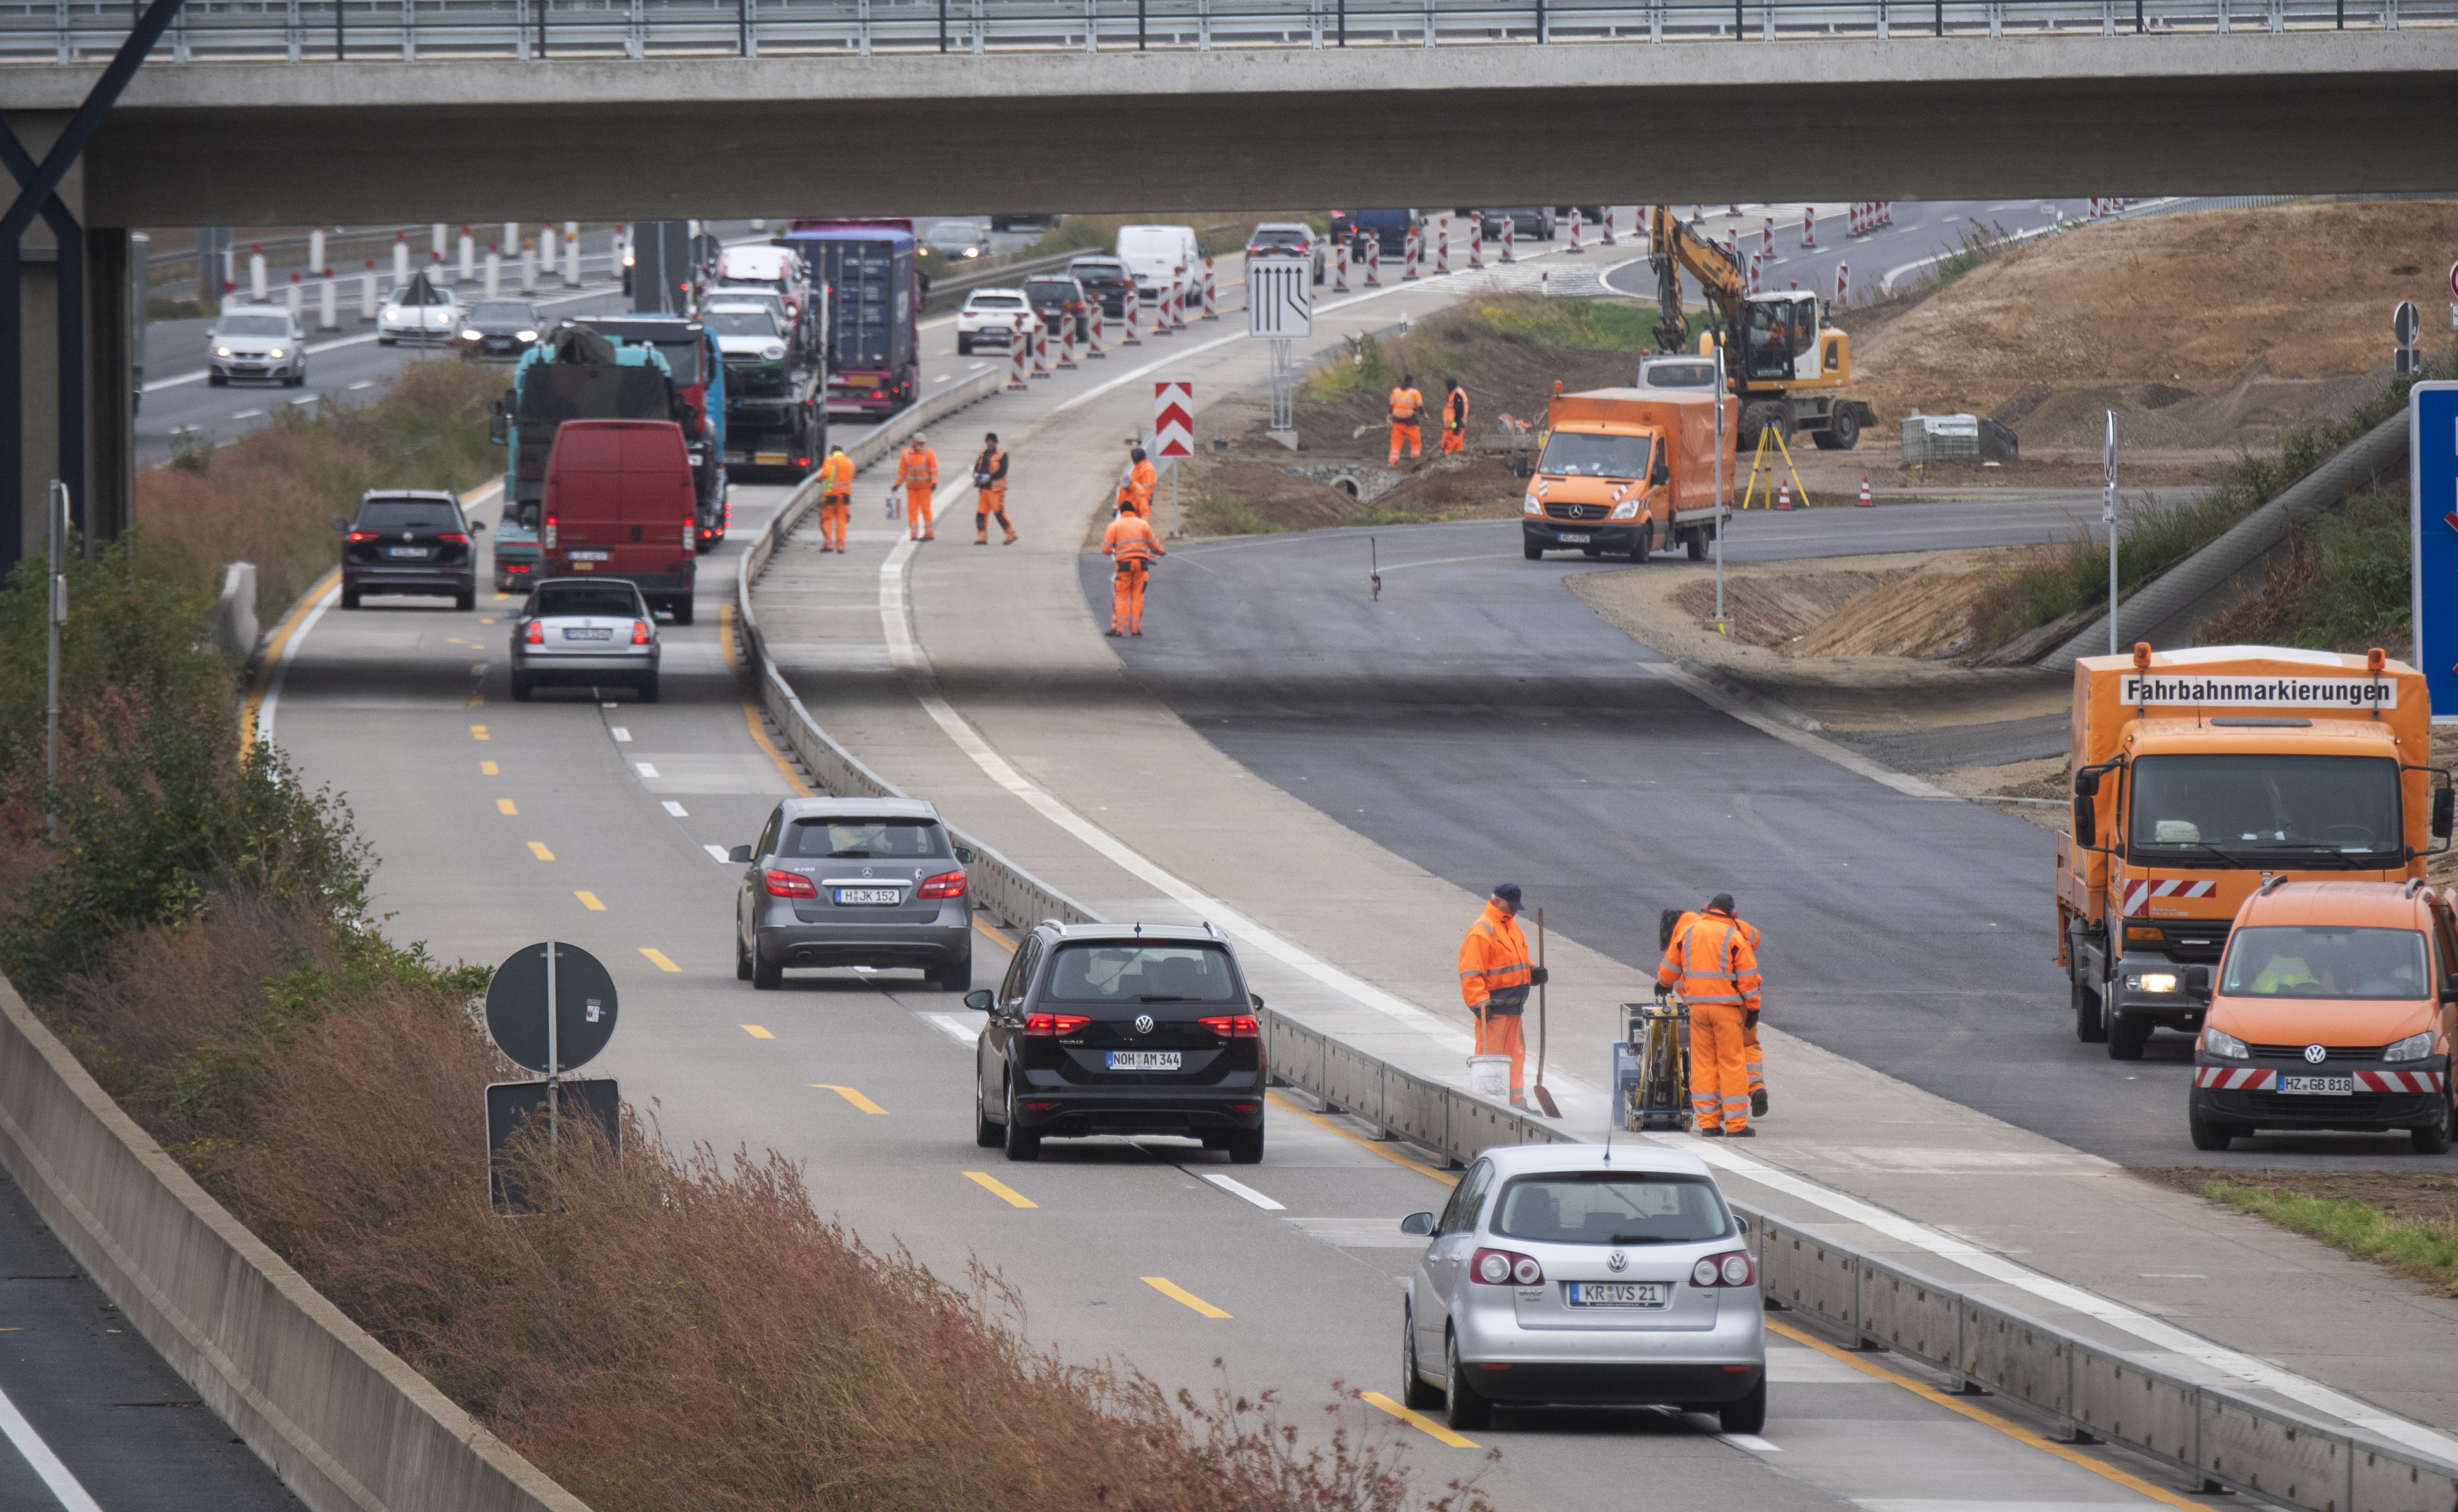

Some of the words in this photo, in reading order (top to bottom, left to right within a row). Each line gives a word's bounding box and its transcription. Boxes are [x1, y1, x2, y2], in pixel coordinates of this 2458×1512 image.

[2128, 680, 2390, 705] Fahrbahnmarkierungen
[845, 891, 852, 901] H
[859, 891, 873, 901] JK
[877, 891, 895, 901] 152
[1113, 1053, 1135, 1065] NOH
[1143, 1053, 1157, 1066] AM
[1159, 1054, 1180, 1066] 344
[2286, 1078, 2301, 1090] HZ
[2310, 1079, 2326, 1091] GB
[2328, 1079, 2351, 1091] 818
[1585, 1286, 1605, 1301] KR
[1616, 1286, 1635, 1301] VS
[1639, 1286, 1658, 1301] 21
